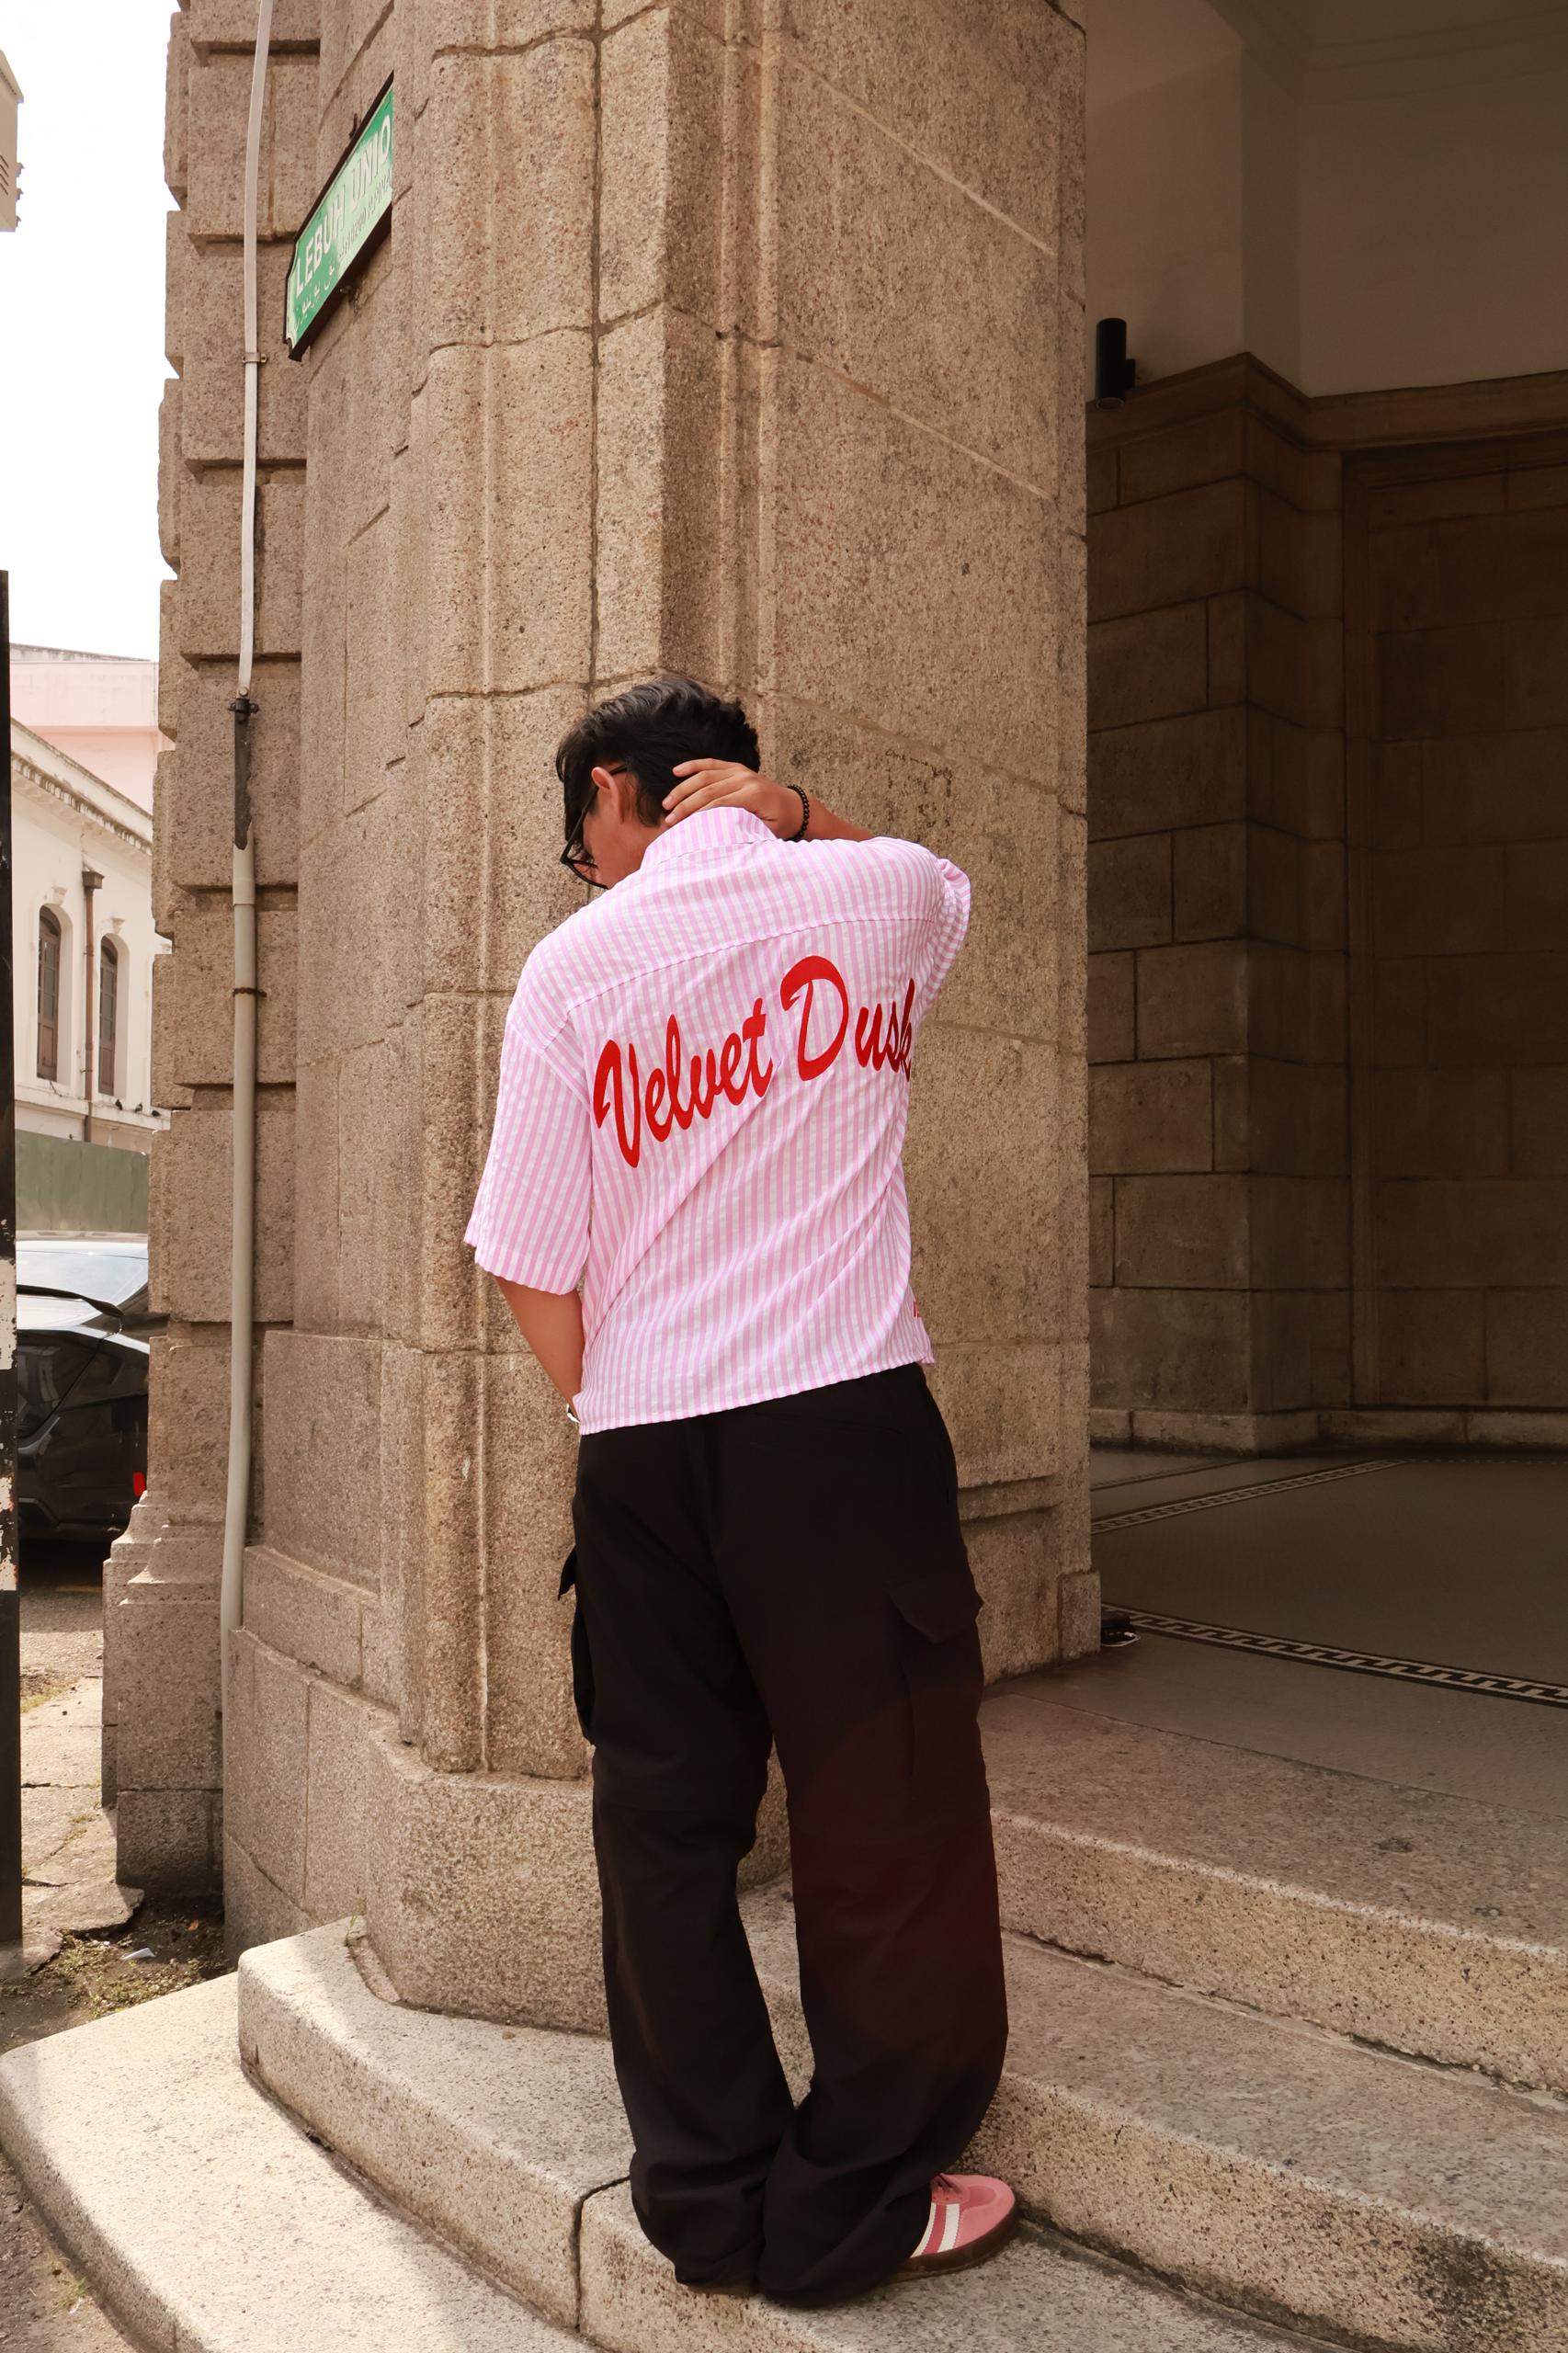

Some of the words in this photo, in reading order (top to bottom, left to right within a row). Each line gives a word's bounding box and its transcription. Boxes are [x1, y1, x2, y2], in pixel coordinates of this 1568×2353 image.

[296, 183, 346, 299] LEBUH
[350, 114, 391, 212] UNIO
[594, 998, 773, 1167] Velvet
[780, 956, 915, 1081] Dusk
